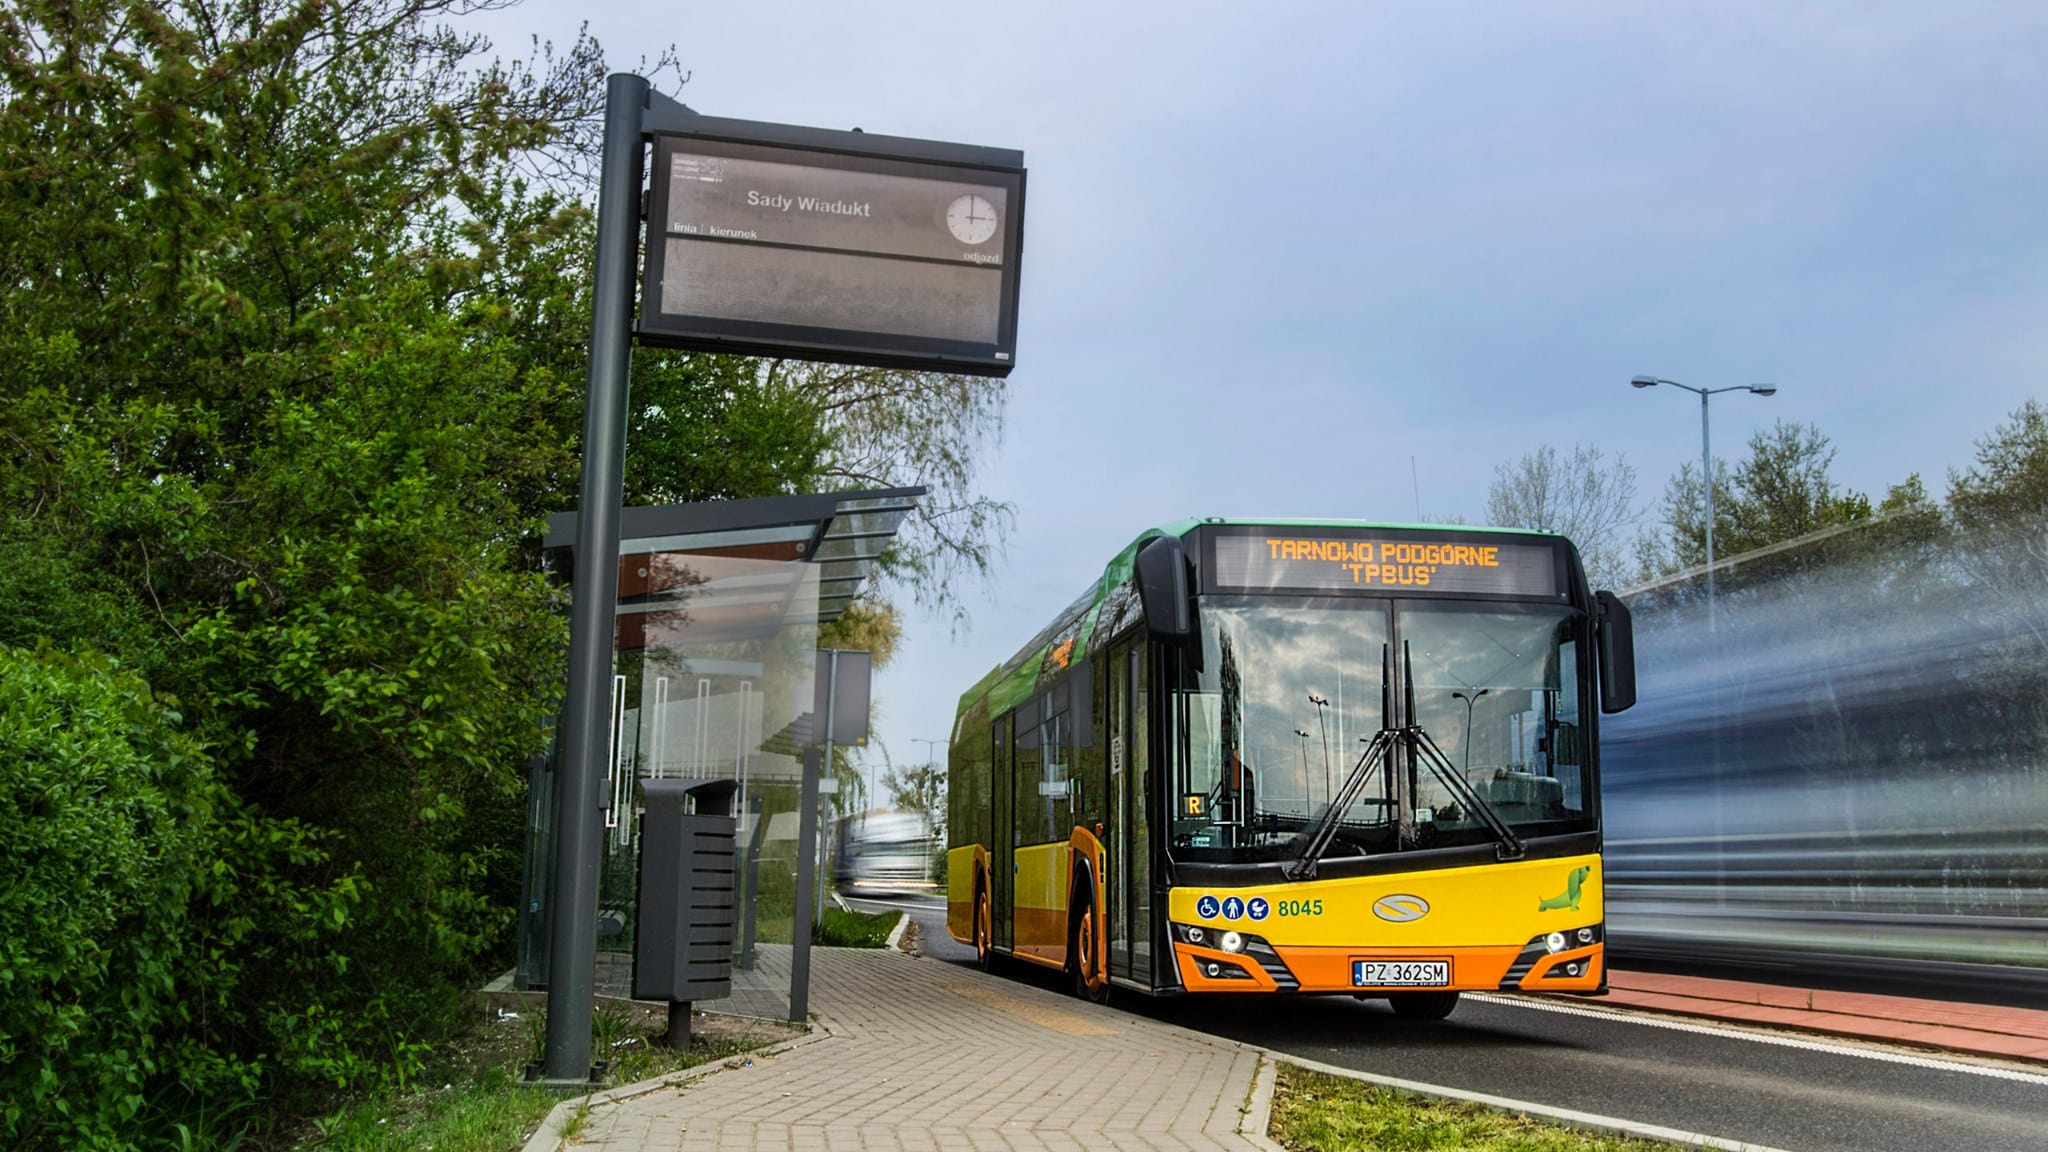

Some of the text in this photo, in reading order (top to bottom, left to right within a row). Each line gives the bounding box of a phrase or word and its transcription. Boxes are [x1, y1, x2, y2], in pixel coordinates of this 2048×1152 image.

[747, 190, 870, 217] Sady Wiadukt
[673, 222, 697, 233] linia
[710, 225, 758, 239] kierunek
[963, 251, 999, 264] odjazd
[1266, 539, 1373, 561] TARNOWO
[1189, 796, 1201, 814] R
[1278, 899, 1323, 916] 8045
[1365, 964, 1444, 981] PZ 362SM
